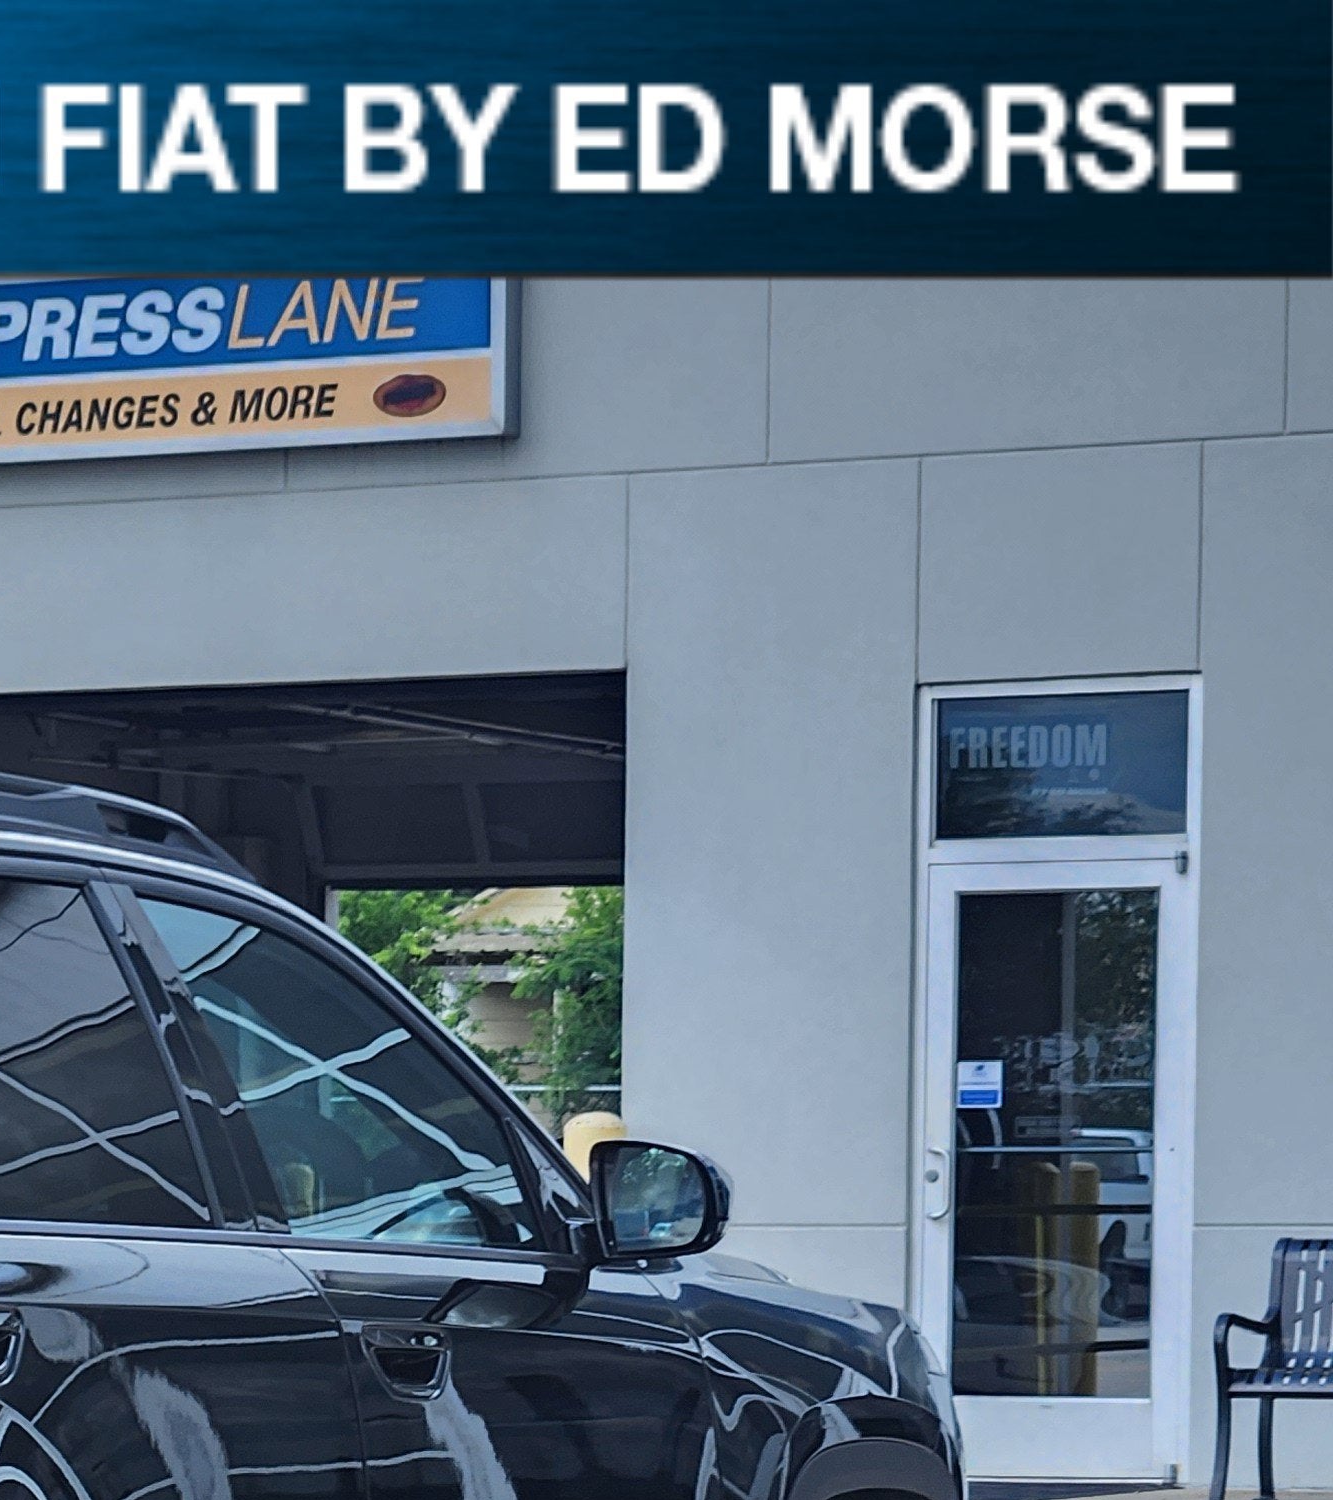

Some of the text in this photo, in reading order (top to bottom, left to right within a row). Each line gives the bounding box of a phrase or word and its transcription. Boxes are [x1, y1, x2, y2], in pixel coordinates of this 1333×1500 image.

[15, 391, 178, 437] CHANGES
[190, 388, 216, 427] &
[228, 382, 338, 424] MORE
[948, 723, 1108, 769] FREEDOM
